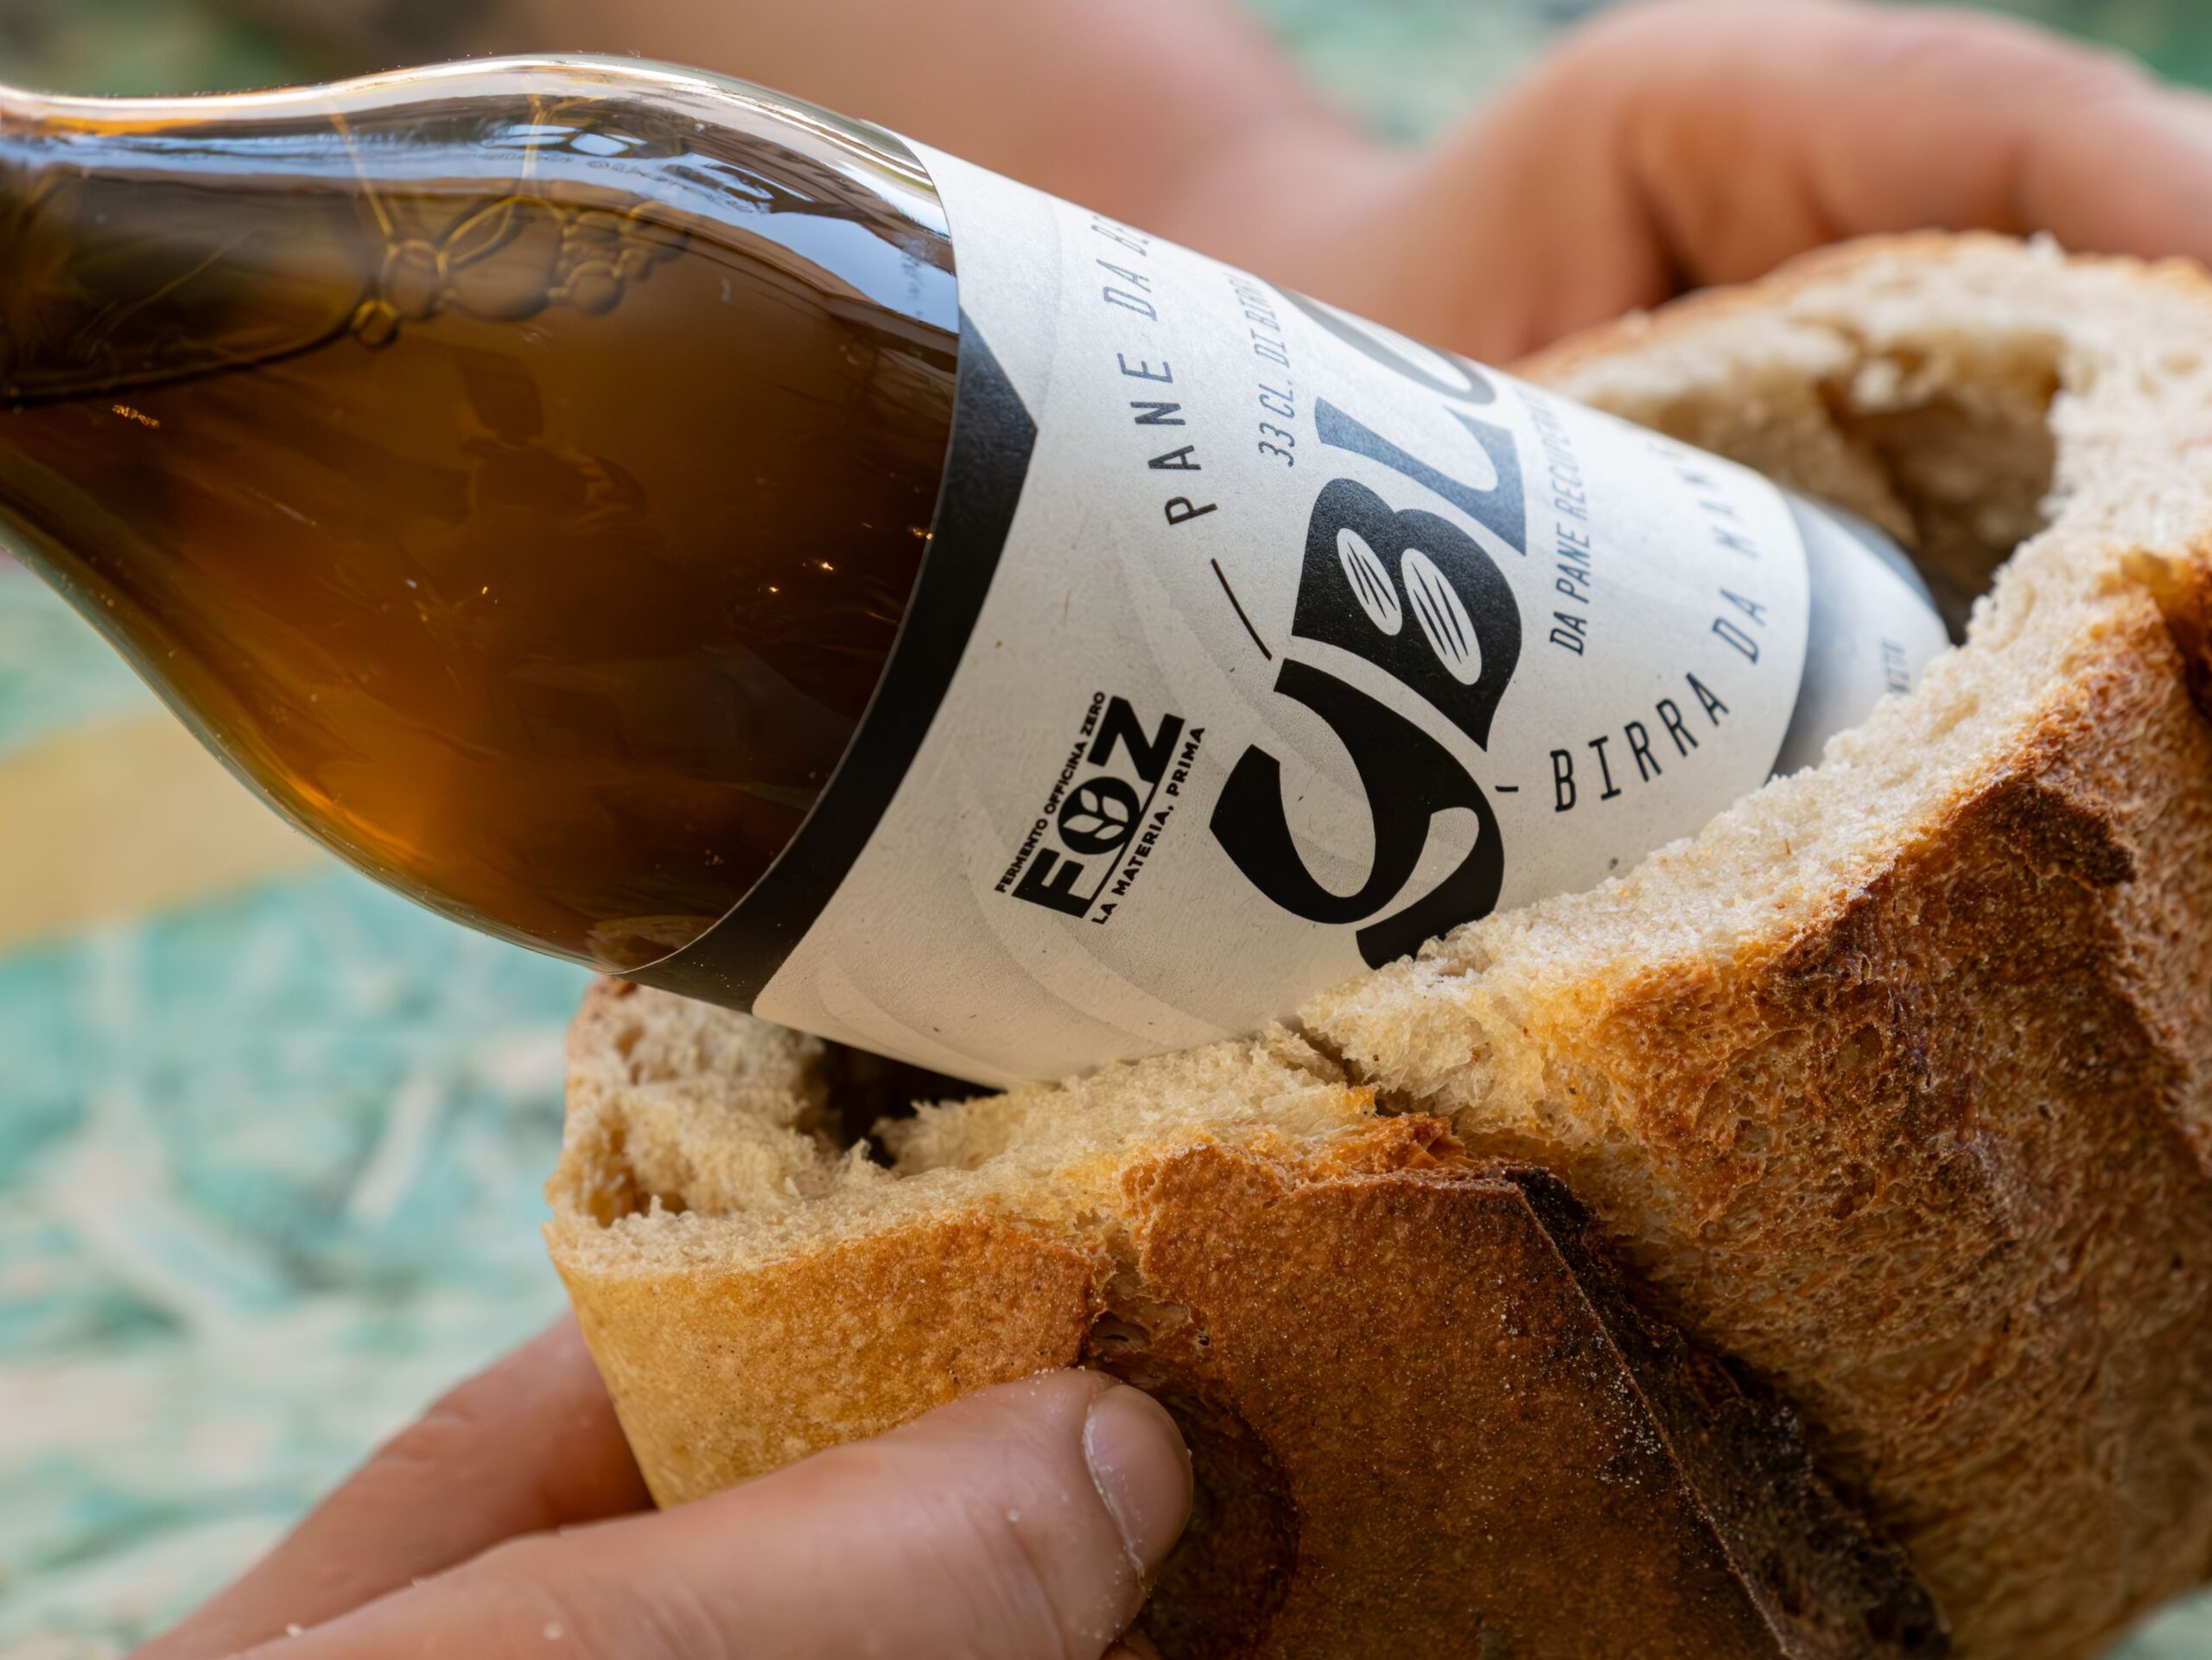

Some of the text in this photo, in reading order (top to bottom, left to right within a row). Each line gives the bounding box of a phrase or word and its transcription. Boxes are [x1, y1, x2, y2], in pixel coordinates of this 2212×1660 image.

[1095, 258, 1159, 322] DA
[1249, 328, 1291, 369] DI
[1117, 352, 1218, 525] PANE
[1258, 380, 1296, 420] CL.
[1258, 422, 1296, 467] 33
[1555, 522, 1592, 605] PANE
[1549, 611, 1588, 657] DA
[1549, 671, 1730, 812] BIRRA
[1711, 588, 1768, 665] DA
[994, 691, 1106, 894] FERMENTO OFFICINA ZERO
[1011, 695, 1185, 919] FOZ
[1090, 727, 1206, 925] LA MATERIA, PRIMA
